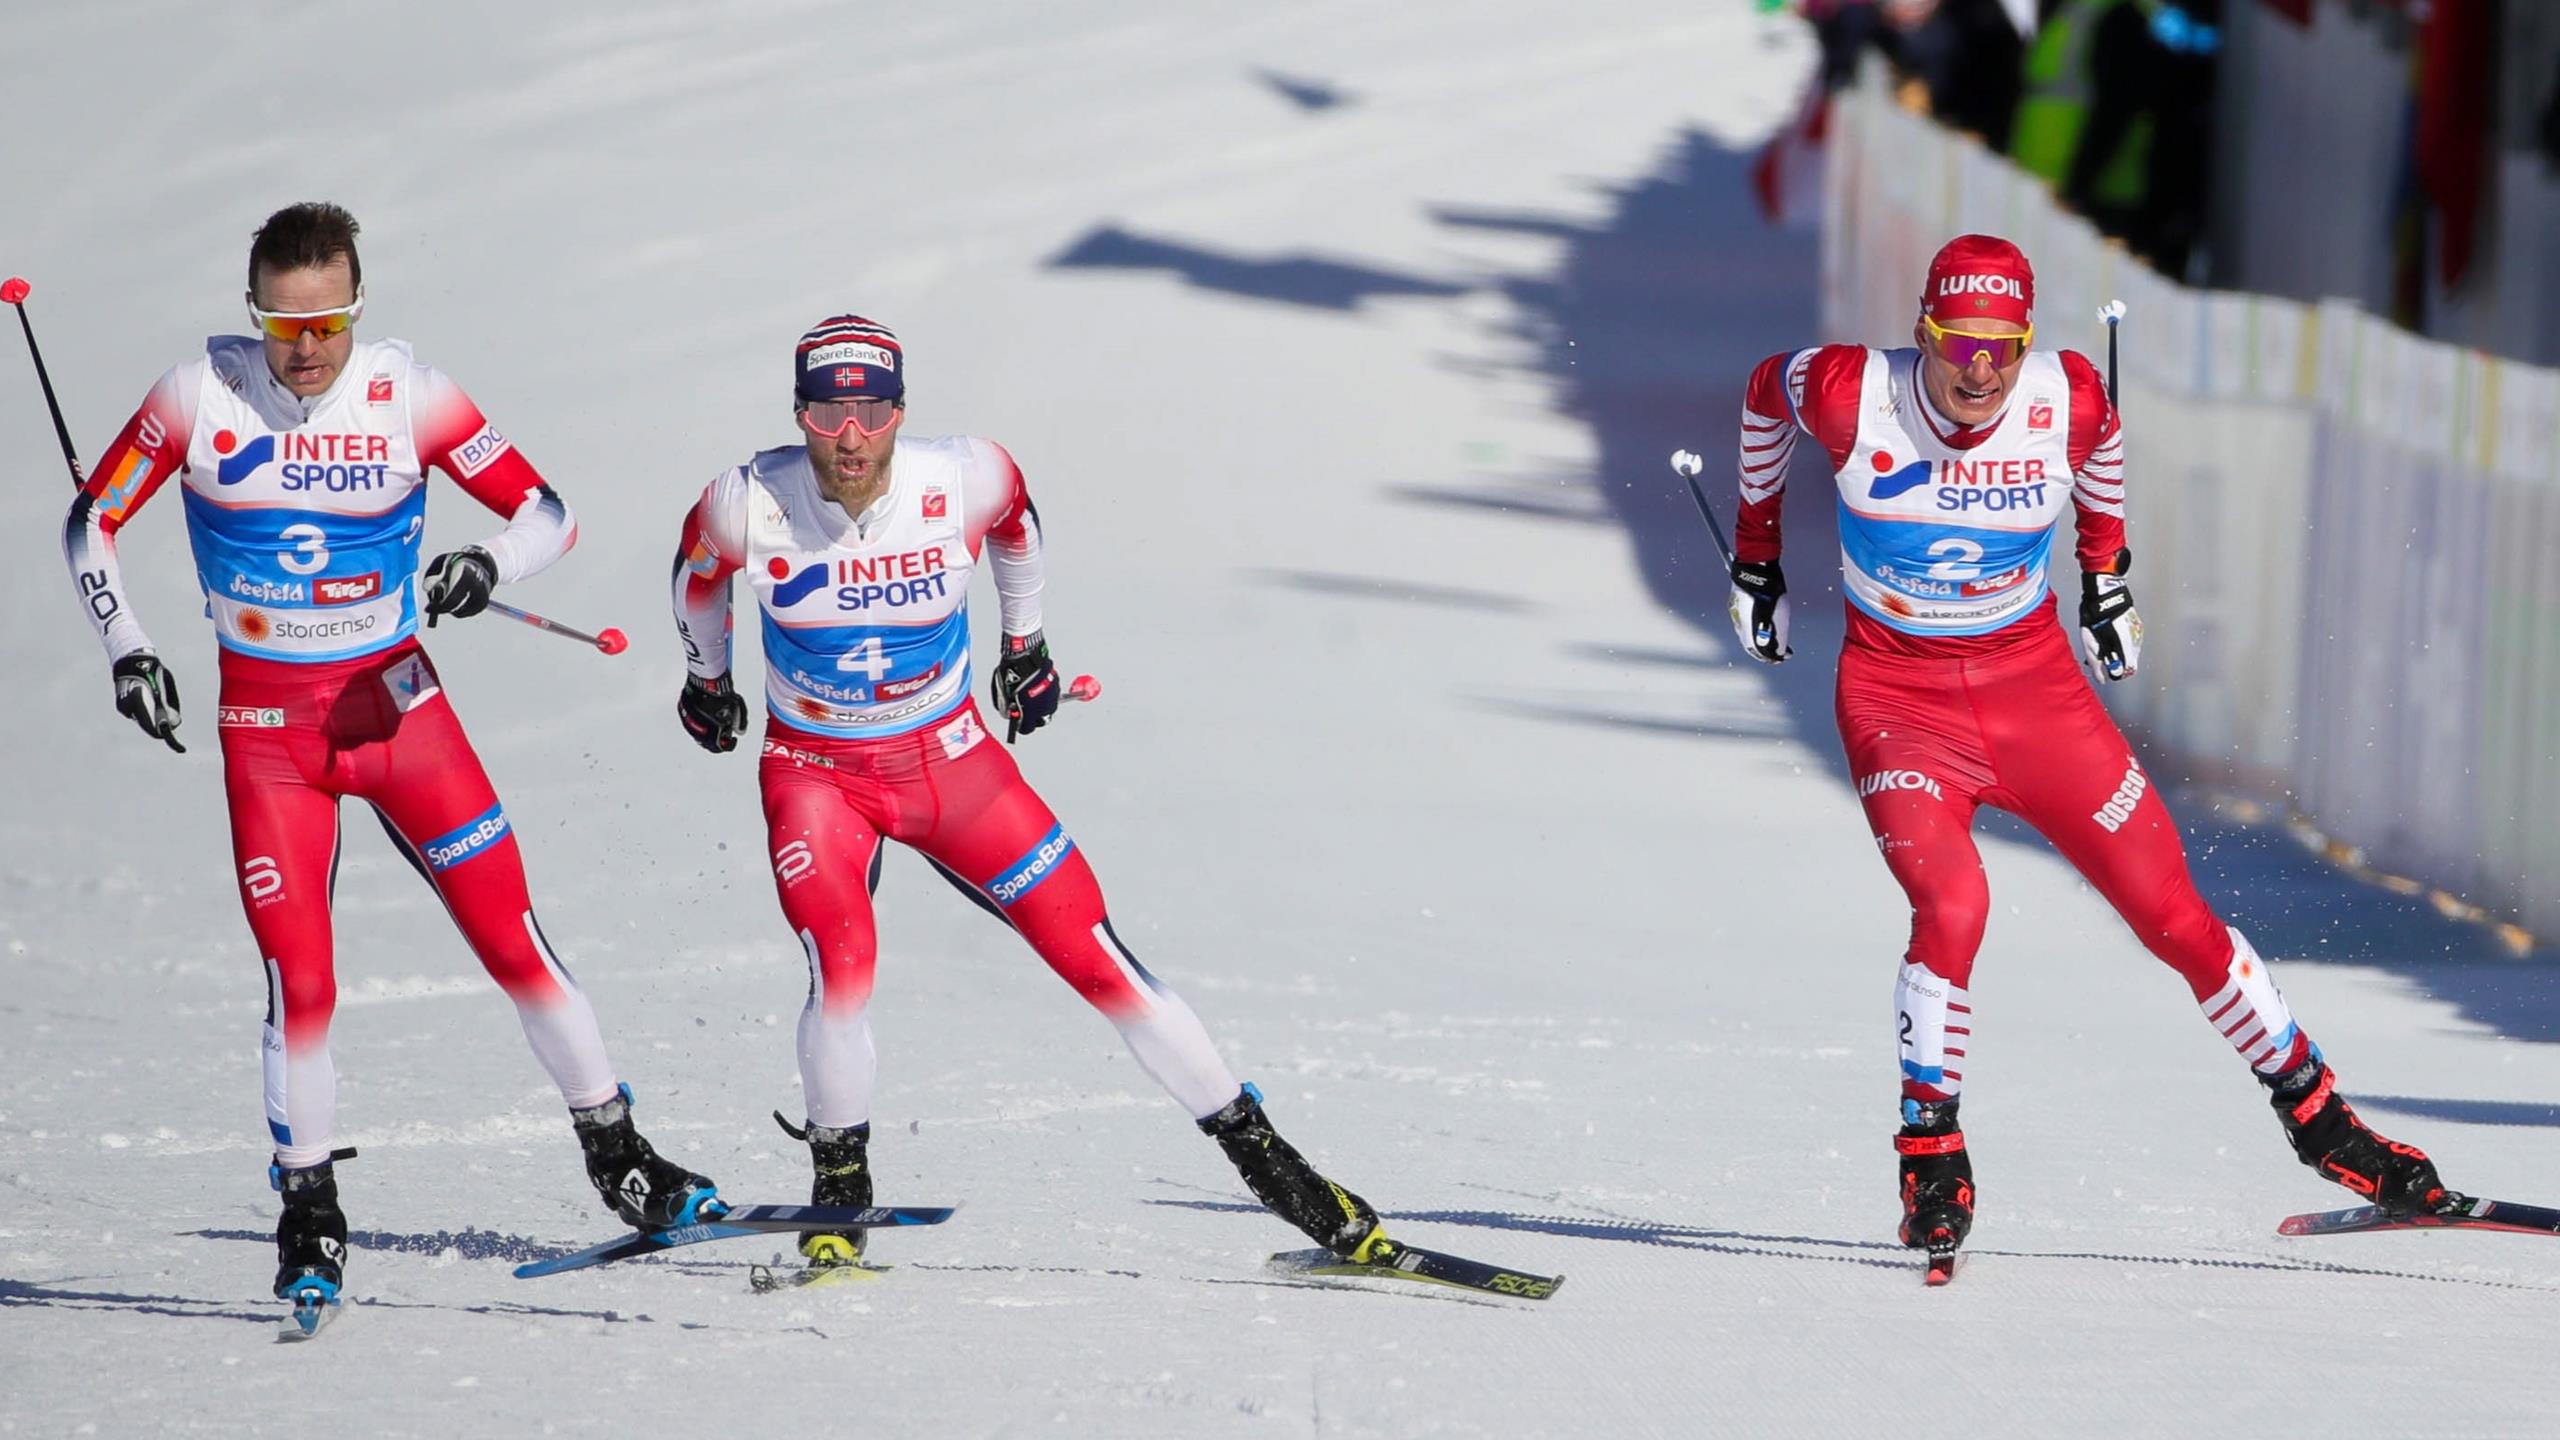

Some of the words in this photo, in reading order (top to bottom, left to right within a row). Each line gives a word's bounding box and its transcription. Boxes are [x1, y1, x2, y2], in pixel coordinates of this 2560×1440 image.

[1939, 274, 2024, 301] LUKOIL
[283, 432, 389, 462] INTER
[280, 463, 390, 492] SPORT
[1940, 458, 2046, 486] INTER
[1936, 481, 2047, 512] SPORT
[277, 523, 330, 575] 3
[838, 546, 945, 585] INTER
[1926, 537, 1985, 581] 2
[230, 573, 305, 603] Seefeld
[320, 578, 374, 599] Tirol
[837, 570, 947, 611] SPORT
[275, 614, 376, 639] storaenso
[836, 636, 893, 682] 4
[792, 668, 867, 702] Seefeld
[218, 710, 257, 724] PAR
[1860, 769, 1944, 802] LUKOIL
[2091, 768, 2147, 833] BOSCO
[1899, 1009, 1914, 1048] 2
